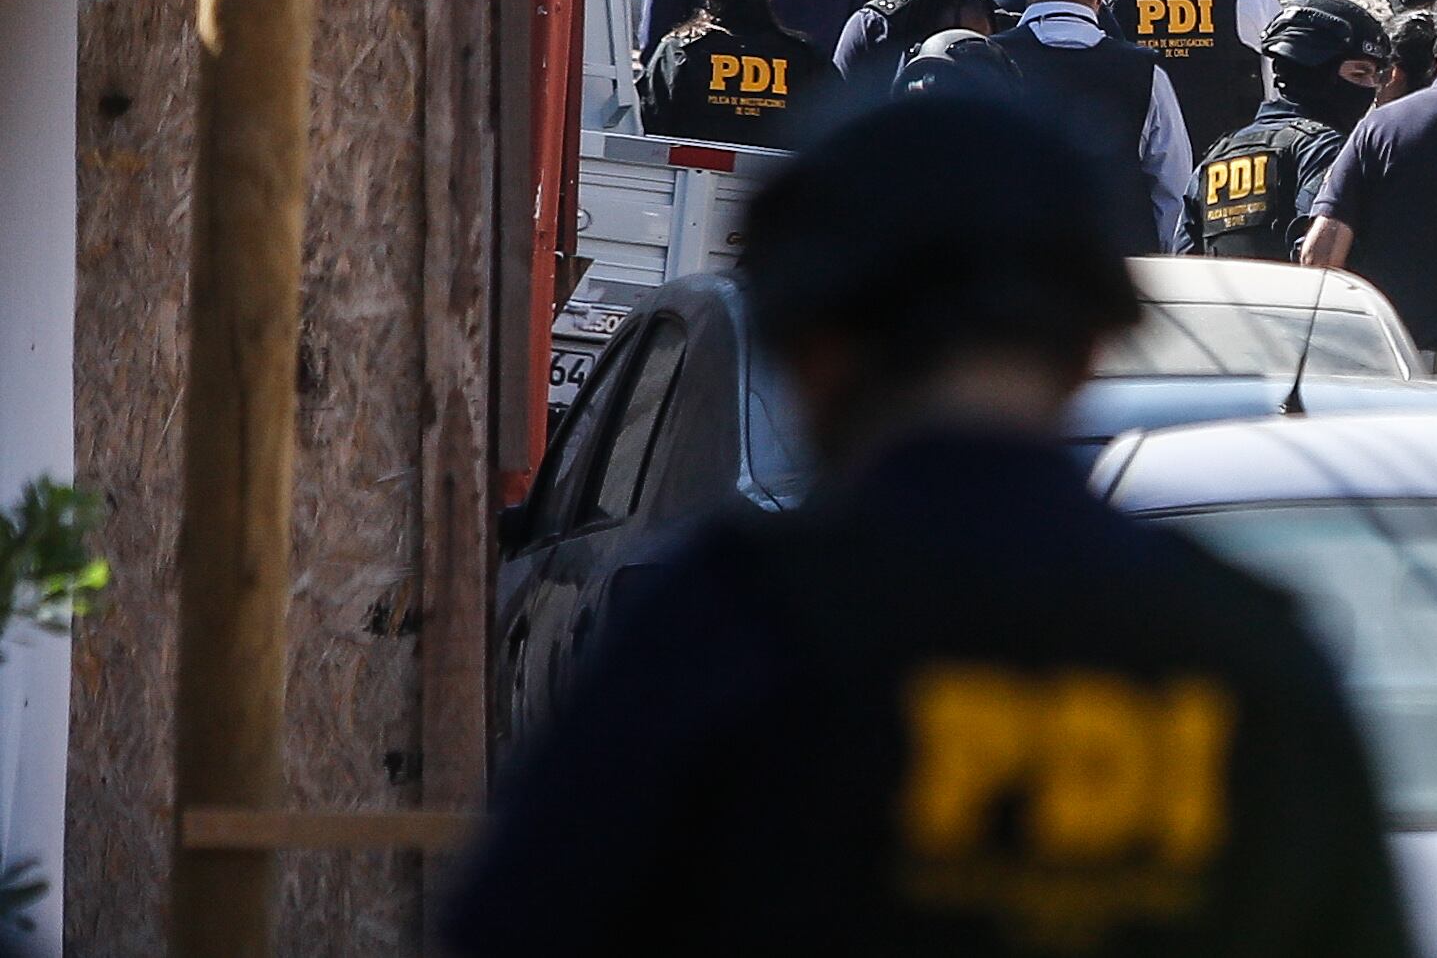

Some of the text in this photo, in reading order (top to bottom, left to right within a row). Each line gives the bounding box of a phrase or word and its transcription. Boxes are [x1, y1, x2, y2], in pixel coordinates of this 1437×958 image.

[709, 54, 788, 95] PDI
[1207, 155, 1268, 205] PDI
[906, 662, 1232, 862] PDI
